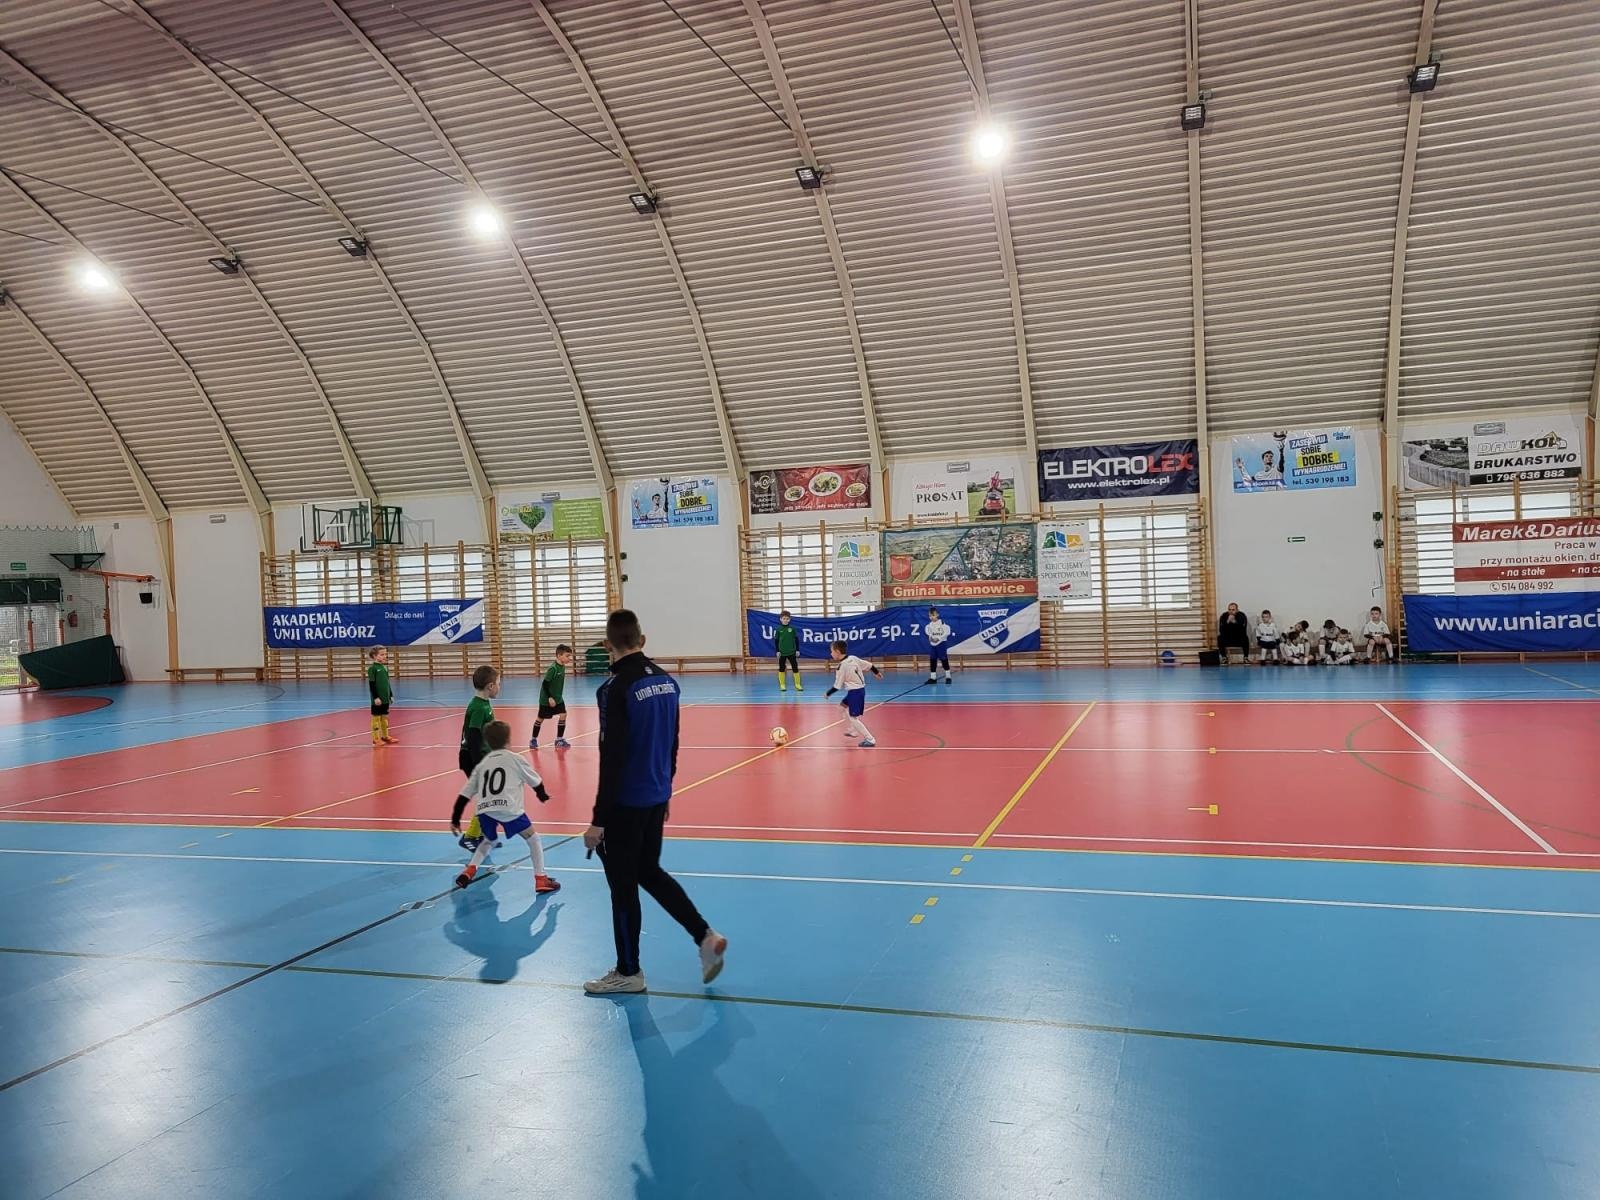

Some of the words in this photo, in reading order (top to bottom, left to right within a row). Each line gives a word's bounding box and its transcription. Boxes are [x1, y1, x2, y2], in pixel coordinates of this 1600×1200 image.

[1043, 453, 1195, 480] ELEKTROLEX
[1302, 453, 1333, 466] DOBRE
[1474, 453, 1577, 469] BRUKARSTWO
[1067, 475, 1171, 490] www.elektrolex.pl
[1496, 473, 1517, 482] 798
[1520, 471, 1541, 480] 636
[1543, 469, 1566, 478] 882
[681, 496, 703, 507] DOBRE
[916, 491, 964, 502] PROSAT
[1554, 541, 1585, 550] Praca
[1480, 557, 1503, 567] przy
[1522, 567, 1546, 576] stałe
[893, 586, 936, 597] Gmina
[941, 583, 1025, 596] Krzanowice
[1501, 583, 1516, 591] 514
[1518, 582, 1535, 591] 084
[1537, 581, 1554, 590] 992
[273, 612, 341, 626] AKADEMIA
[305, 624, 375, 640] RACIBÓRZ
[803, 626, 877, 643] Racibórz
[881, 624, 906, 641] sp.
[911, 623, 920, 636] z
[981, 623, 1005, 639] UNIA
[482, 767, 506, 798] 10
